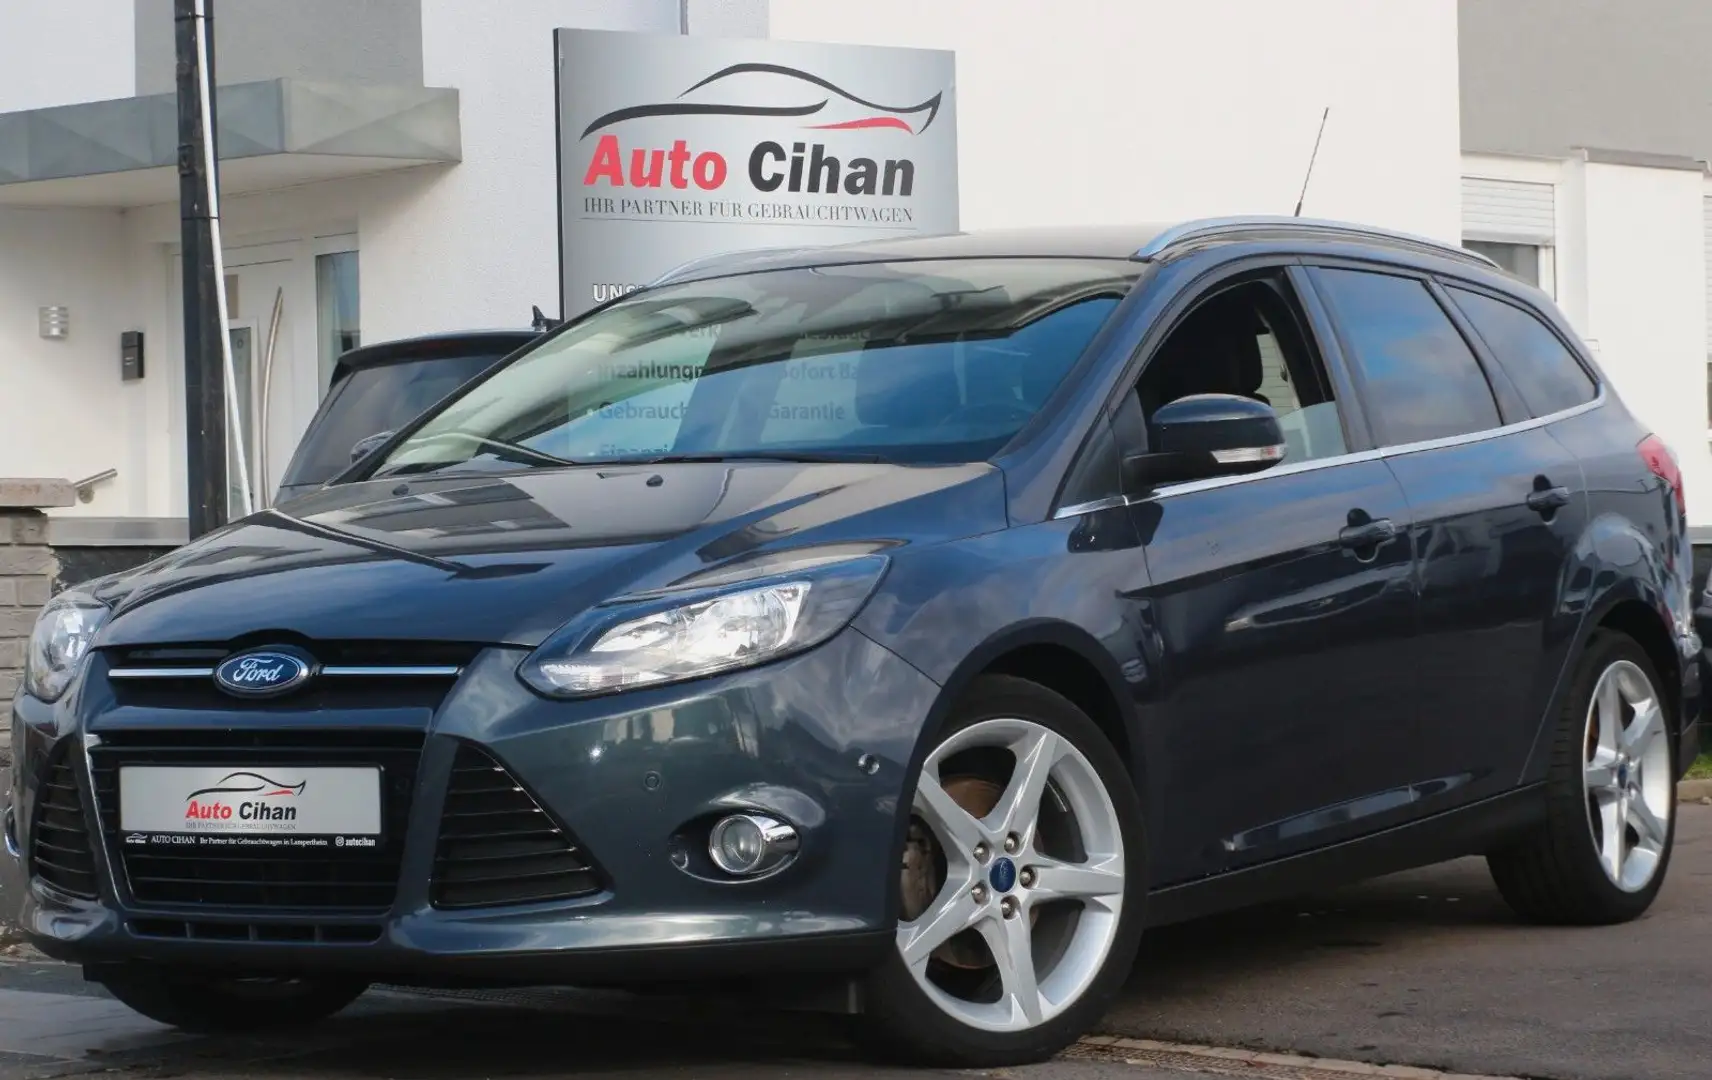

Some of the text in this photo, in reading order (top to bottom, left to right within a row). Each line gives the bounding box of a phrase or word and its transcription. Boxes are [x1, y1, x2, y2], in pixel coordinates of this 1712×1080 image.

[583, 134, 915, 197] Auto Cihan
[584, 196, 616, 214] IHR
[620, 197, 704, 216] PARTNER
[747, 202, 913, 222] GEBRAUCHTWAGEN
[592, 283, 647, 303] UN
[233, 658, 284, 682] Ford
[185, 800, 297, 820] Auto Cihan
[150, 834, 171, 844] AUTO
[171, 835, 196, 845] CIHAN
